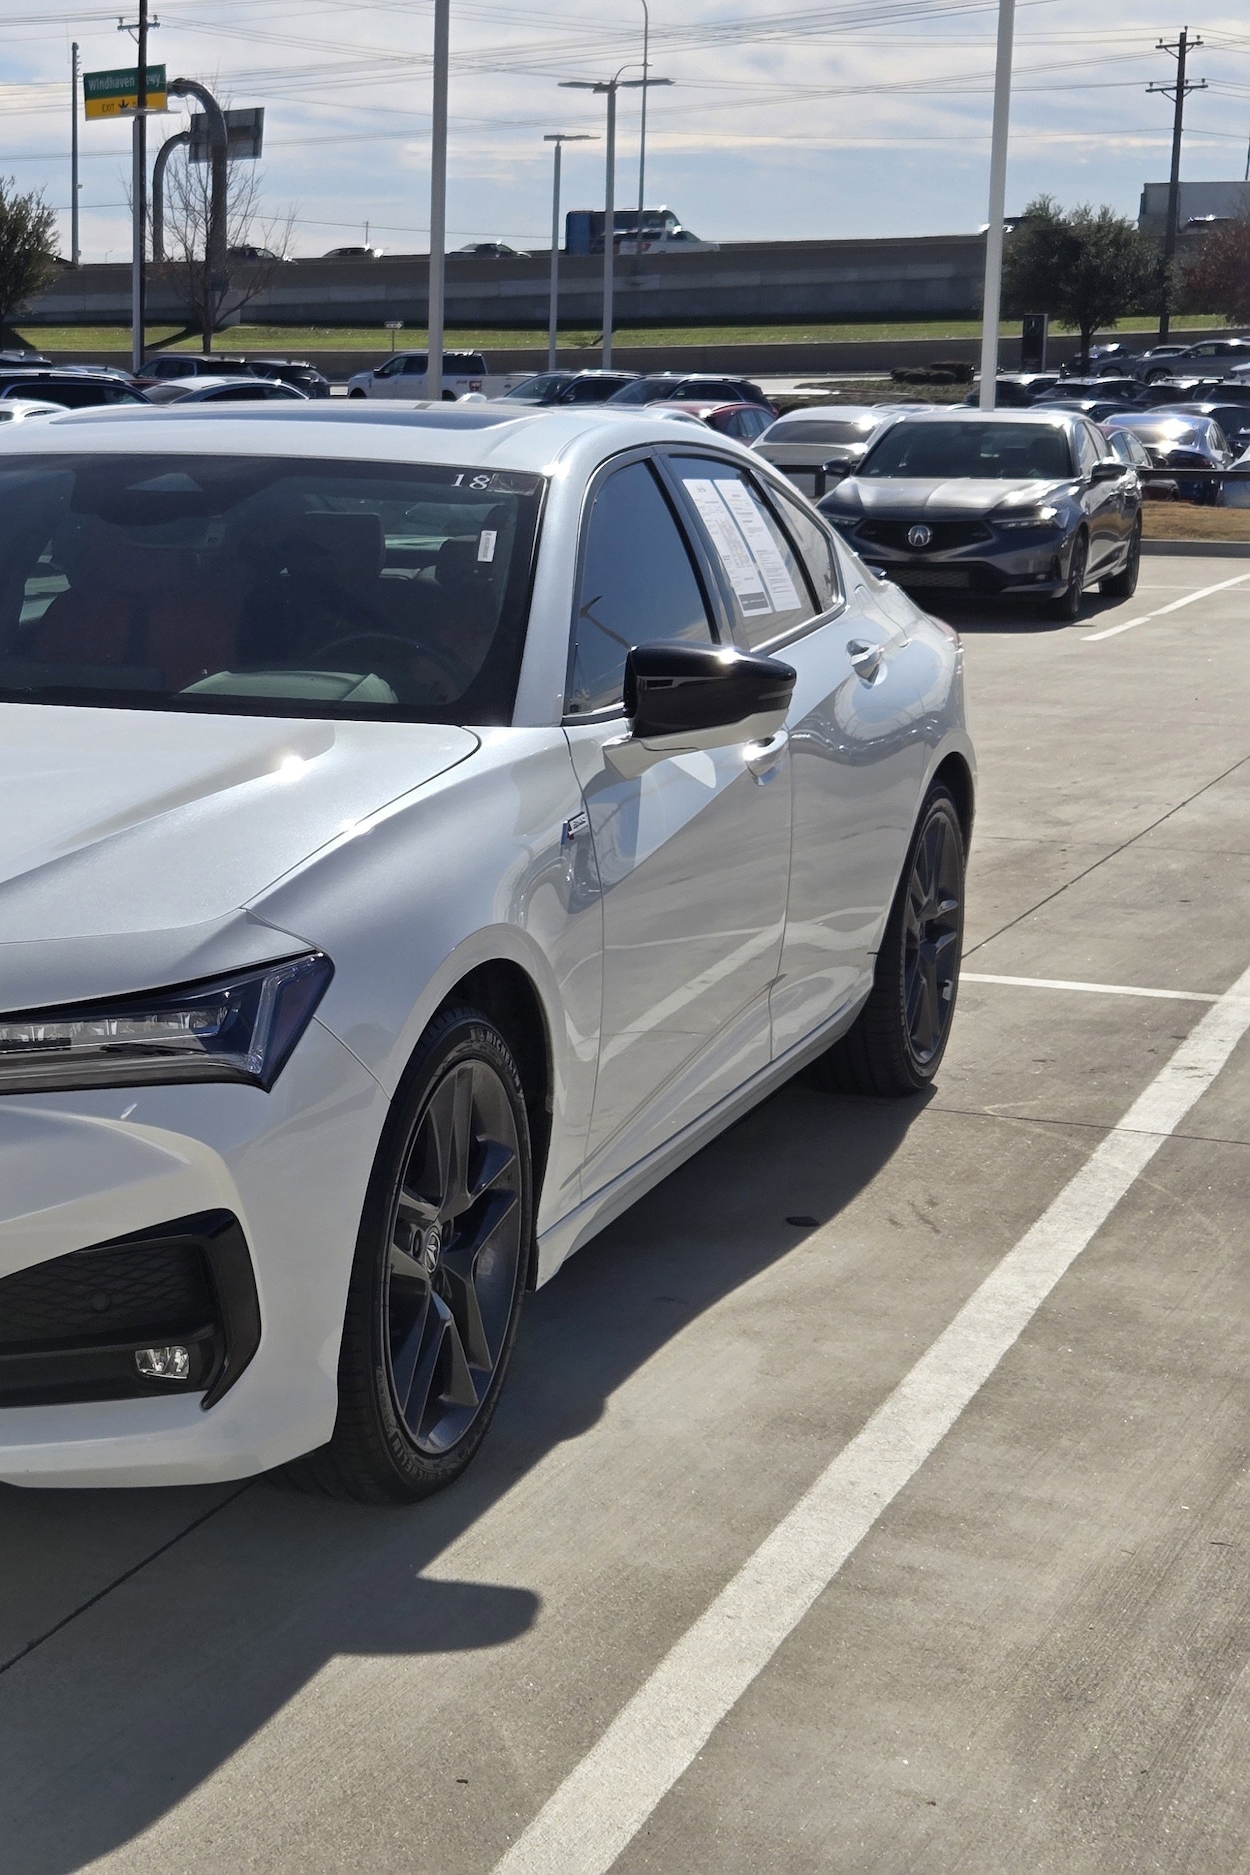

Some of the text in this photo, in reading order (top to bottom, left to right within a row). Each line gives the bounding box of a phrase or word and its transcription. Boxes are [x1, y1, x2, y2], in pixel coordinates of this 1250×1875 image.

[88, 76, 135, 91] Windhaven
[102, 103, 115, 113] EXIT
[450, 473, 490, 490] 18
[485, 1030, 520, 1088] MICHELIN
